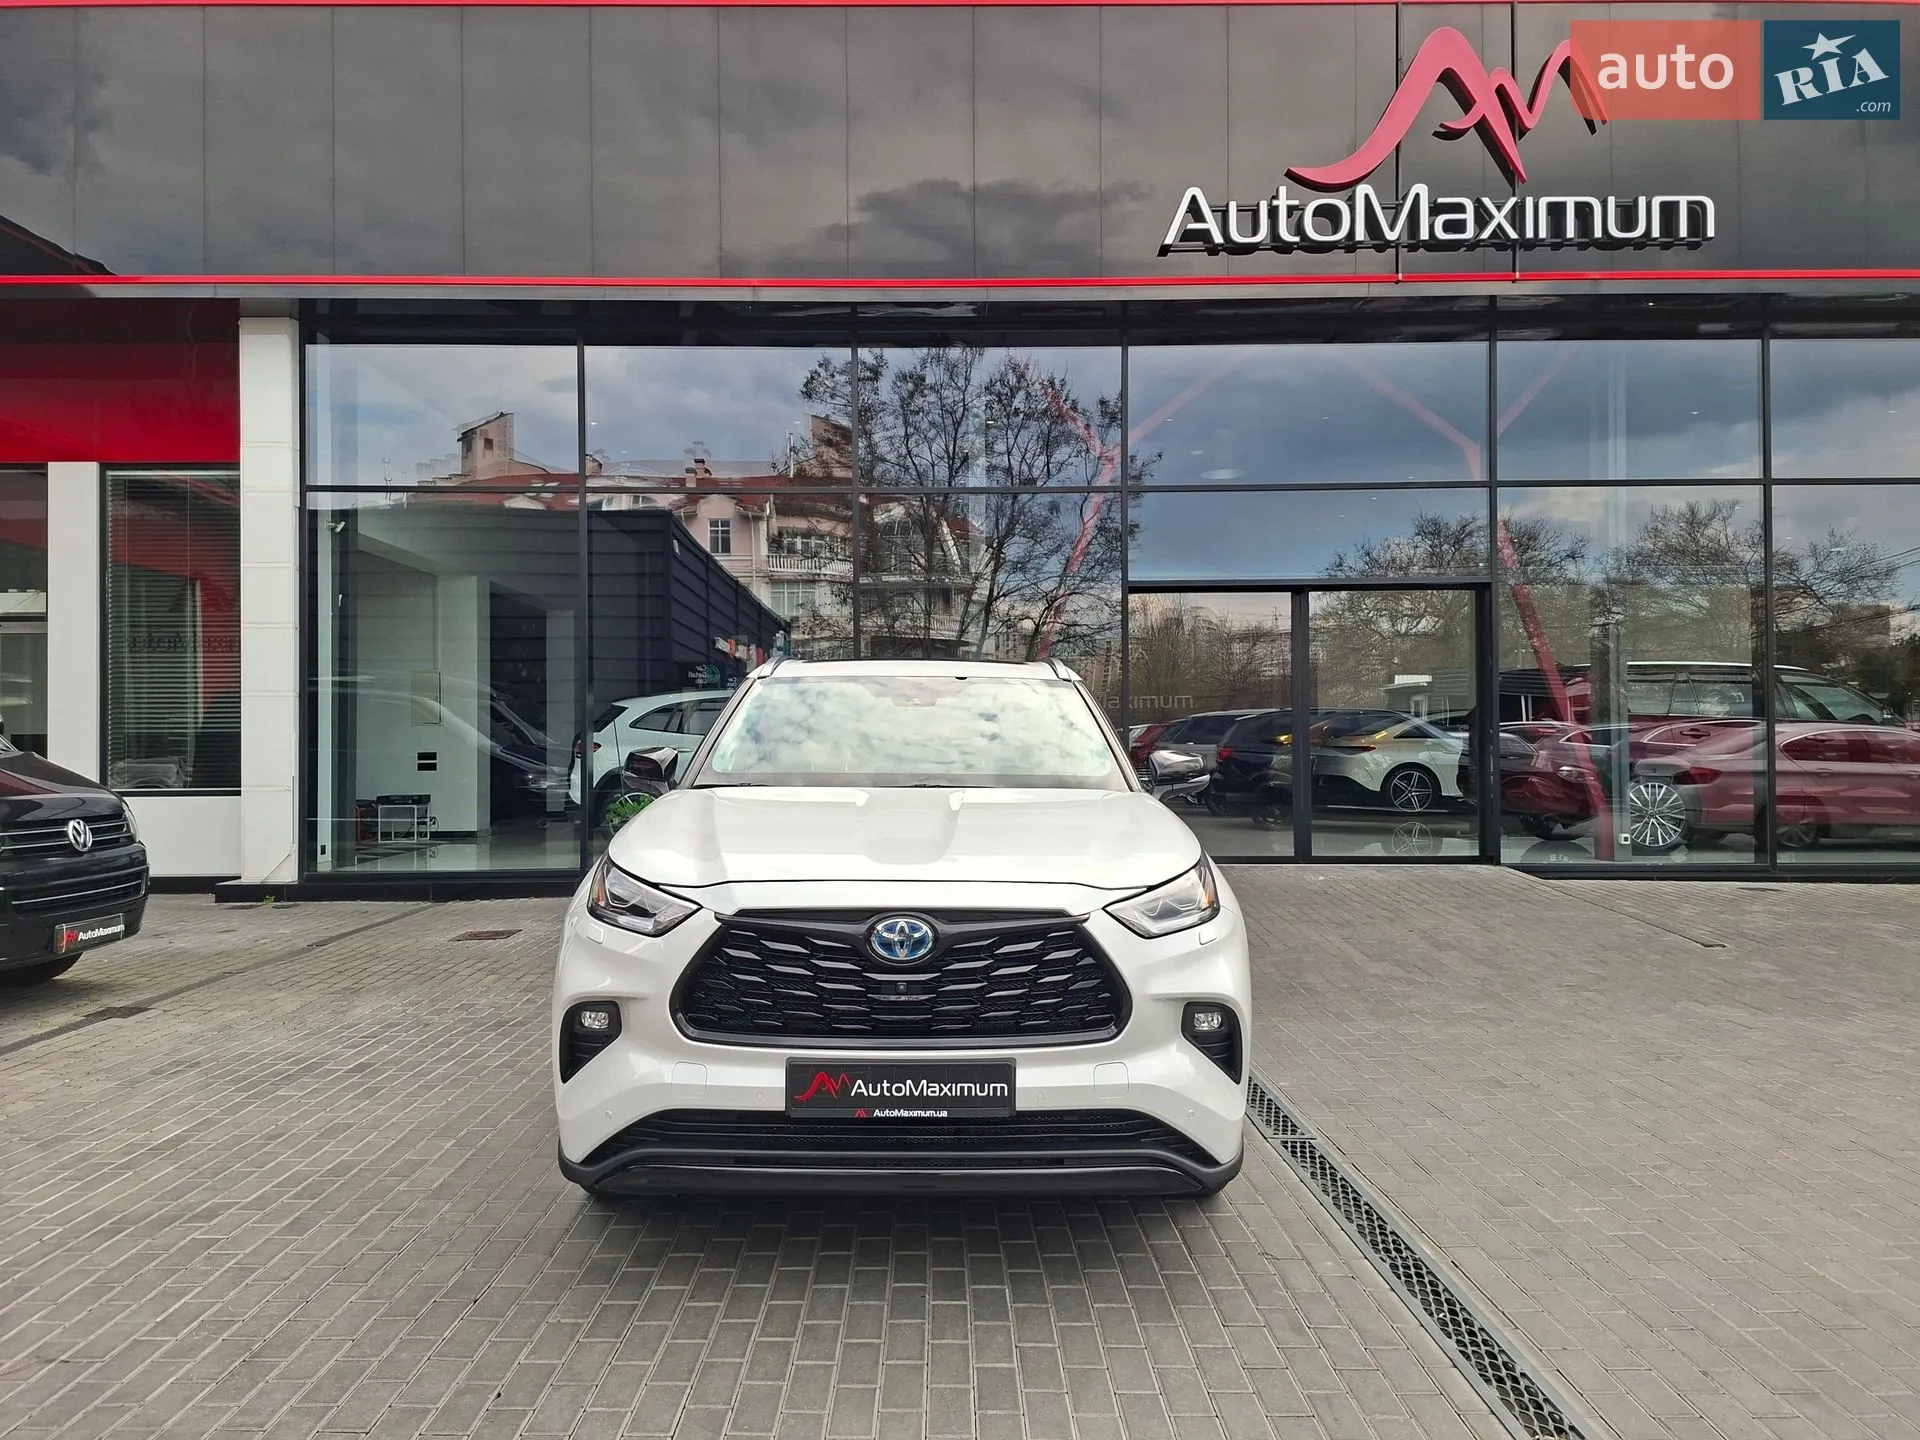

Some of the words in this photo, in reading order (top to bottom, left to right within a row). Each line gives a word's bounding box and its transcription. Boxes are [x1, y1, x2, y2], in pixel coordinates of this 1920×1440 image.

[1162, 183, 1715, 247] AutoMaximum
[850, 1079, 1009, 1097] AutoMaximum
[873, 1108, 948, 1118] AutoMaximum.ua
